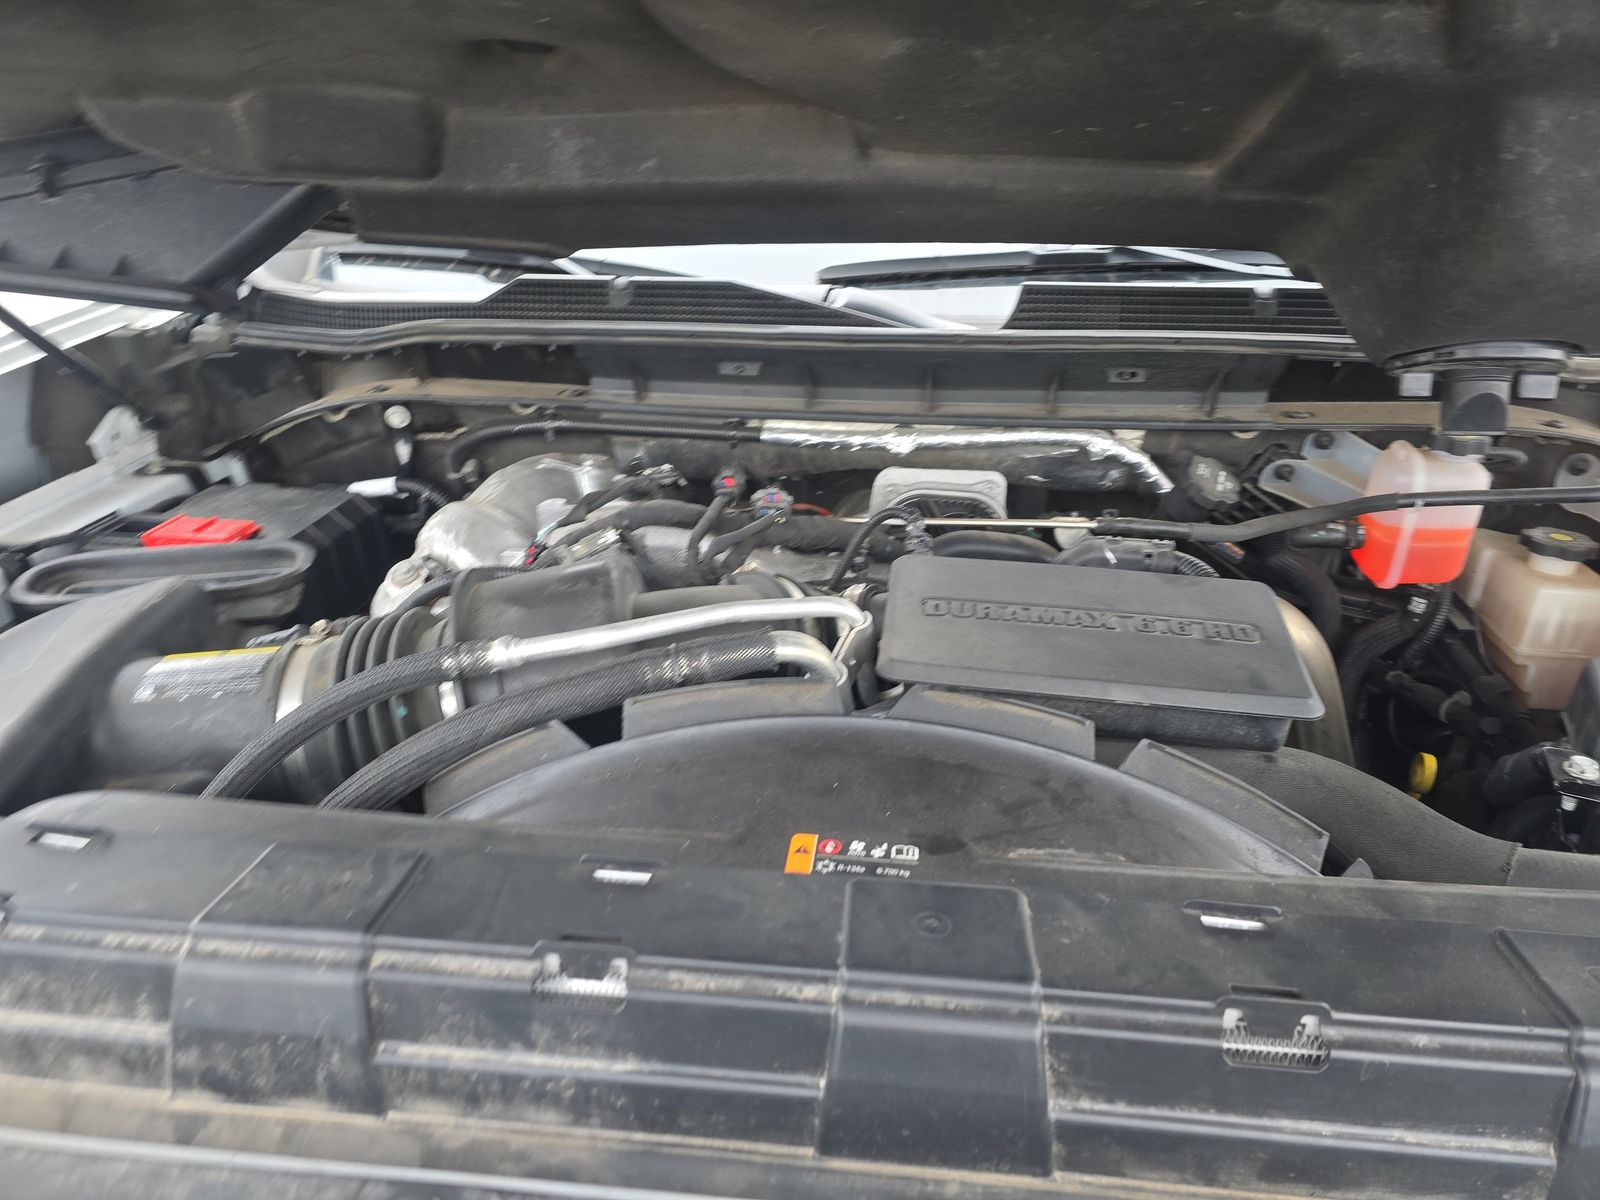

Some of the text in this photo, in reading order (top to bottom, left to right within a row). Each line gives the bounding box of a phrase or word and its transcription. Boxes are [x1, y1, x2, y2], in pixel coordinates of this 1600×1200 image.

[922, 600, 1258, 643] DURAMAX 6.6 HD
